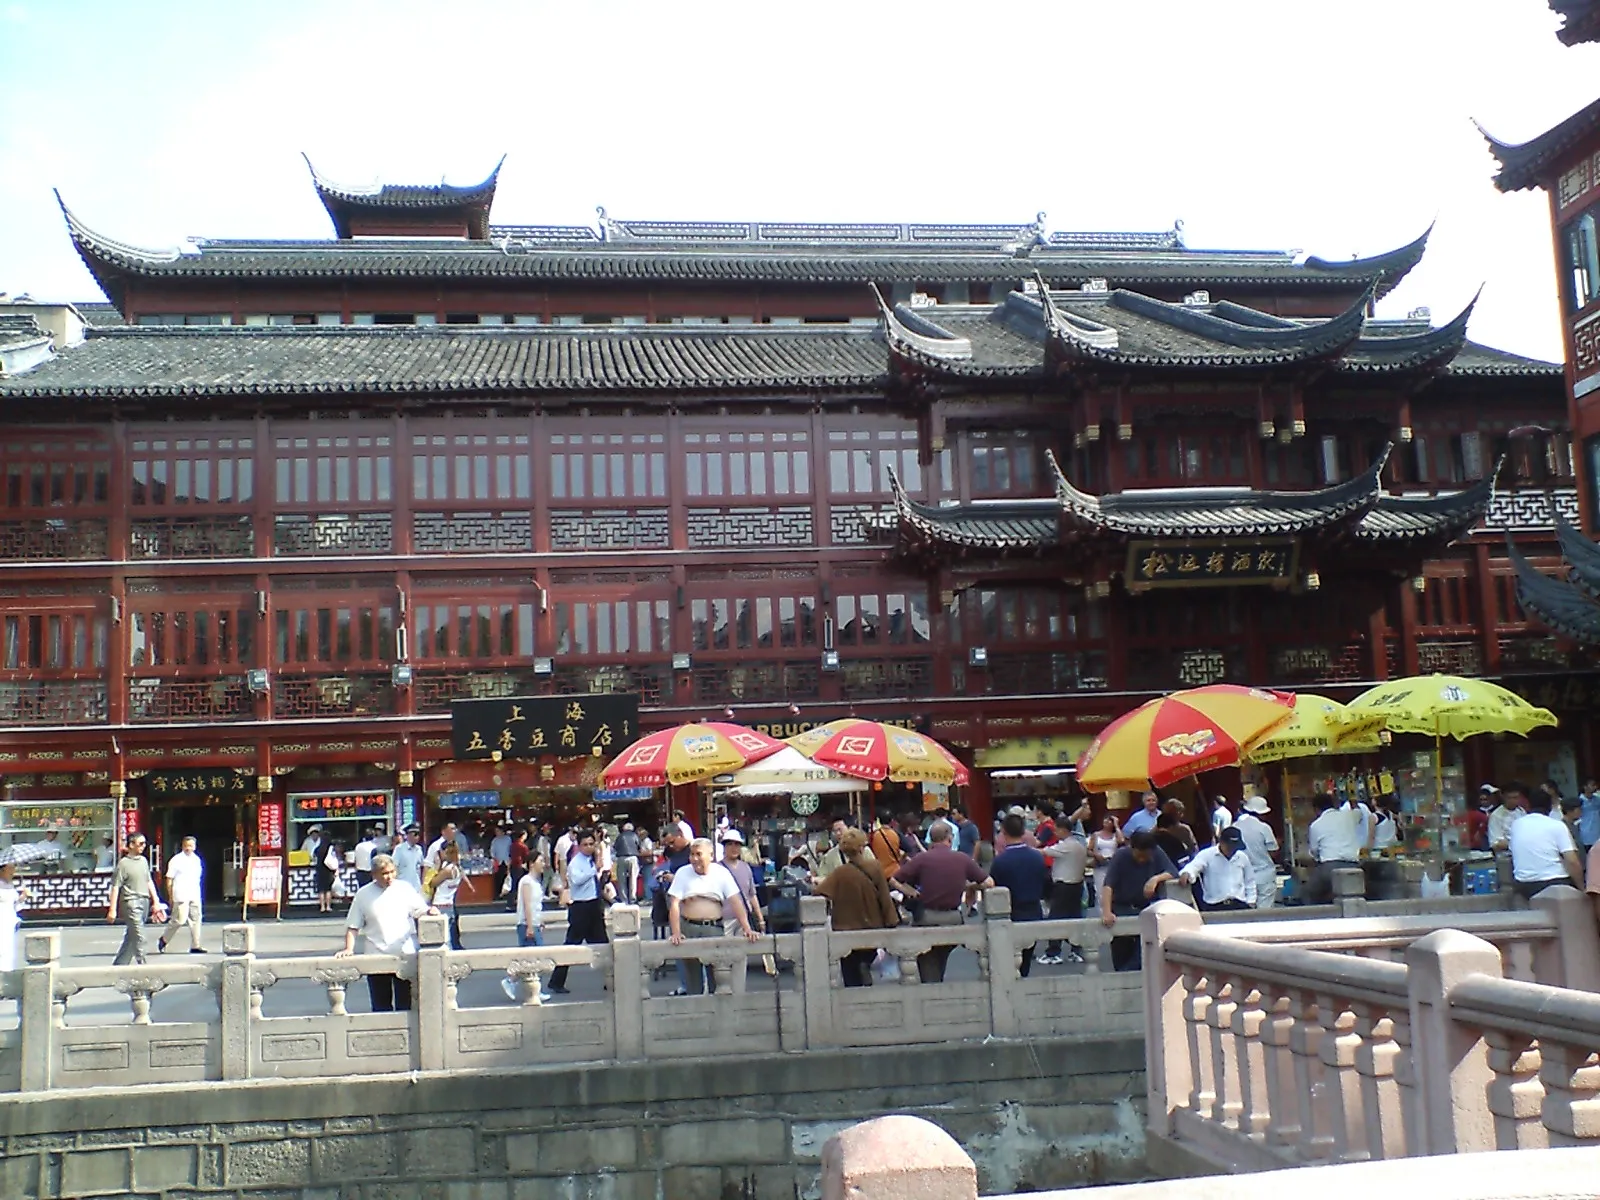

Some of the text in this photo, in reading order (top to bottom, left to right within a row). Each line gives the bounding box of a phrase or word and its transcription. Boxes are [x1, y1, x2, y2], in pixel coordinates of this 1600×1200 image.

[505, 702, 586, 723] 上海
[465, 724, 613, 751] 五香豆商店
